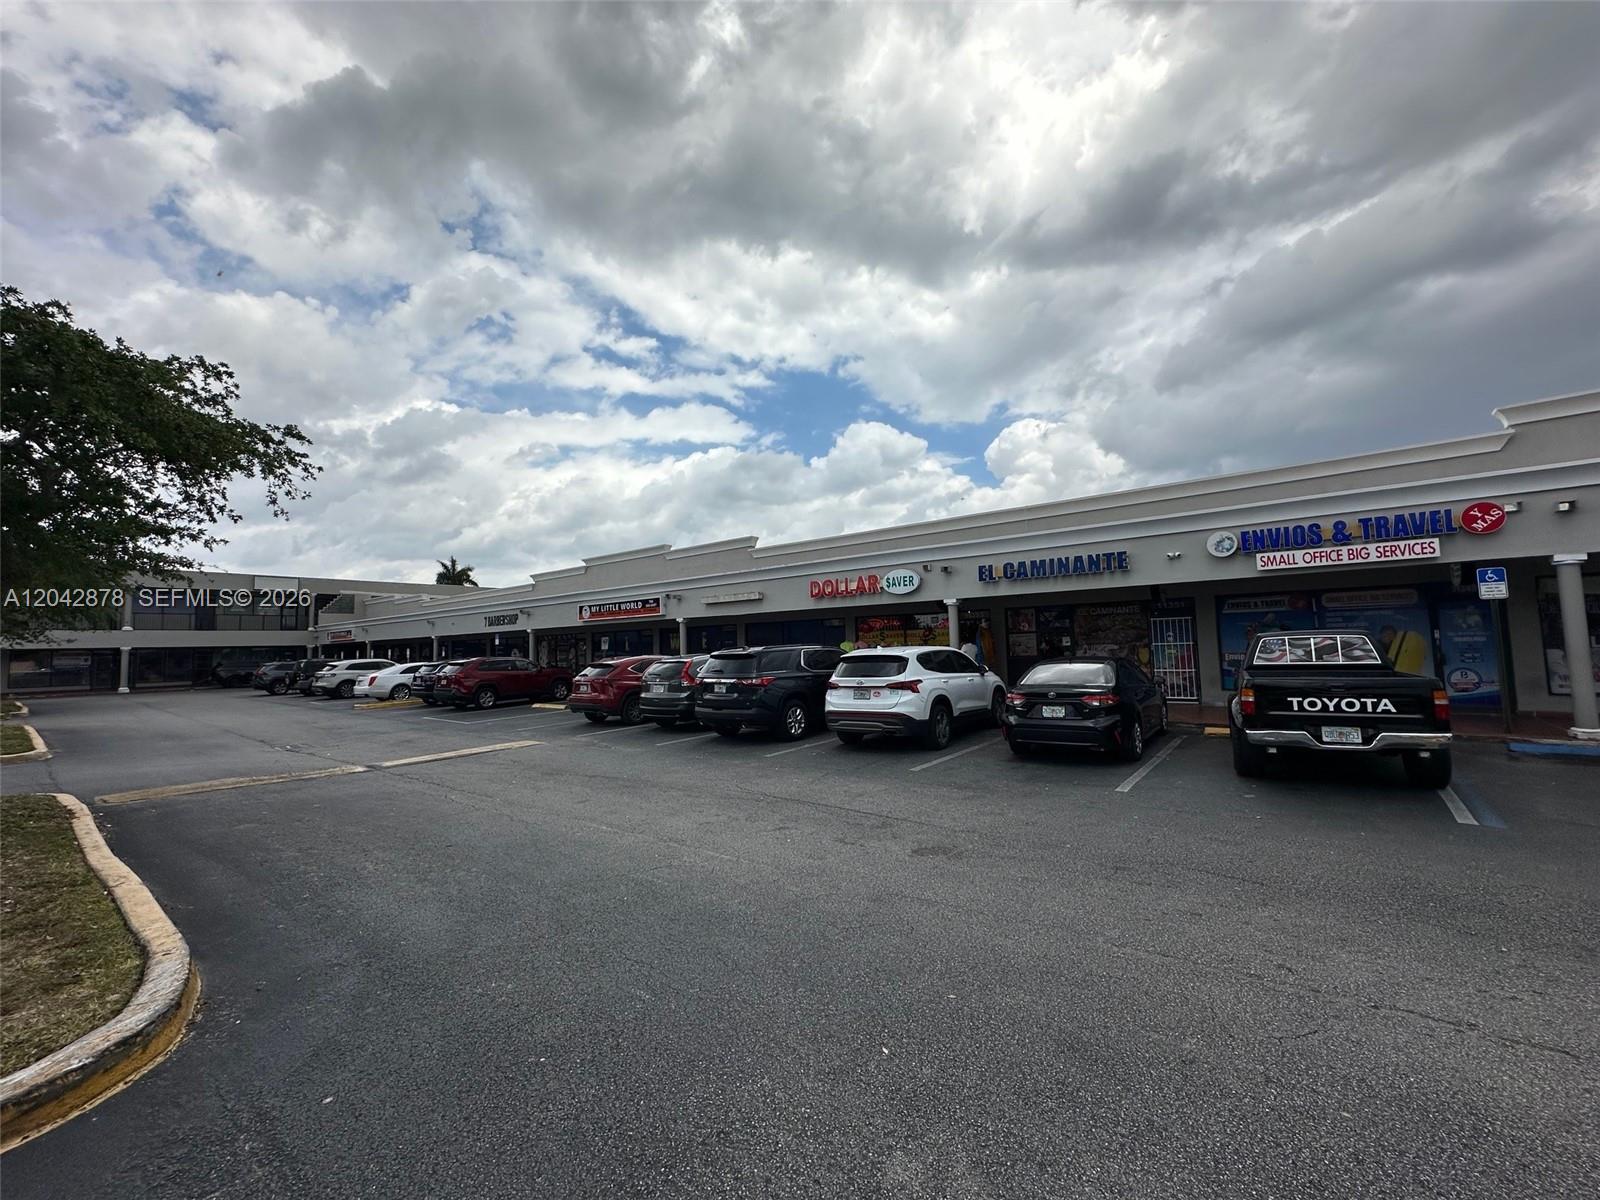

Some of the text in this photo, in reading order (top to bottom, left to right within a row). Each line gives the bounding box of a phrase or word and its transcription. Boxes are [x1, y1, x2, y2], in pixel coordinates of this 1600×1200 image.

[1469, 507, 1483, 518] Y
[1471, 507, 1503, 532] MAS
[1240, 508, 1458, 552] ENVIOS & TRAVEL
[978, 551, 1129, 582] EL CAMINANTE
[1260, 541, 1436, 567] SMALL OFFICE BIG SERVICES
[810, 574, 880, 599] DOLLAR
[591, 605, 600, 613] MY
[600, 603, 619, 612] LITTLE
[620, 601, 643, 610] WORLD
[1287, 697, 1397, 713] TOYOTA
